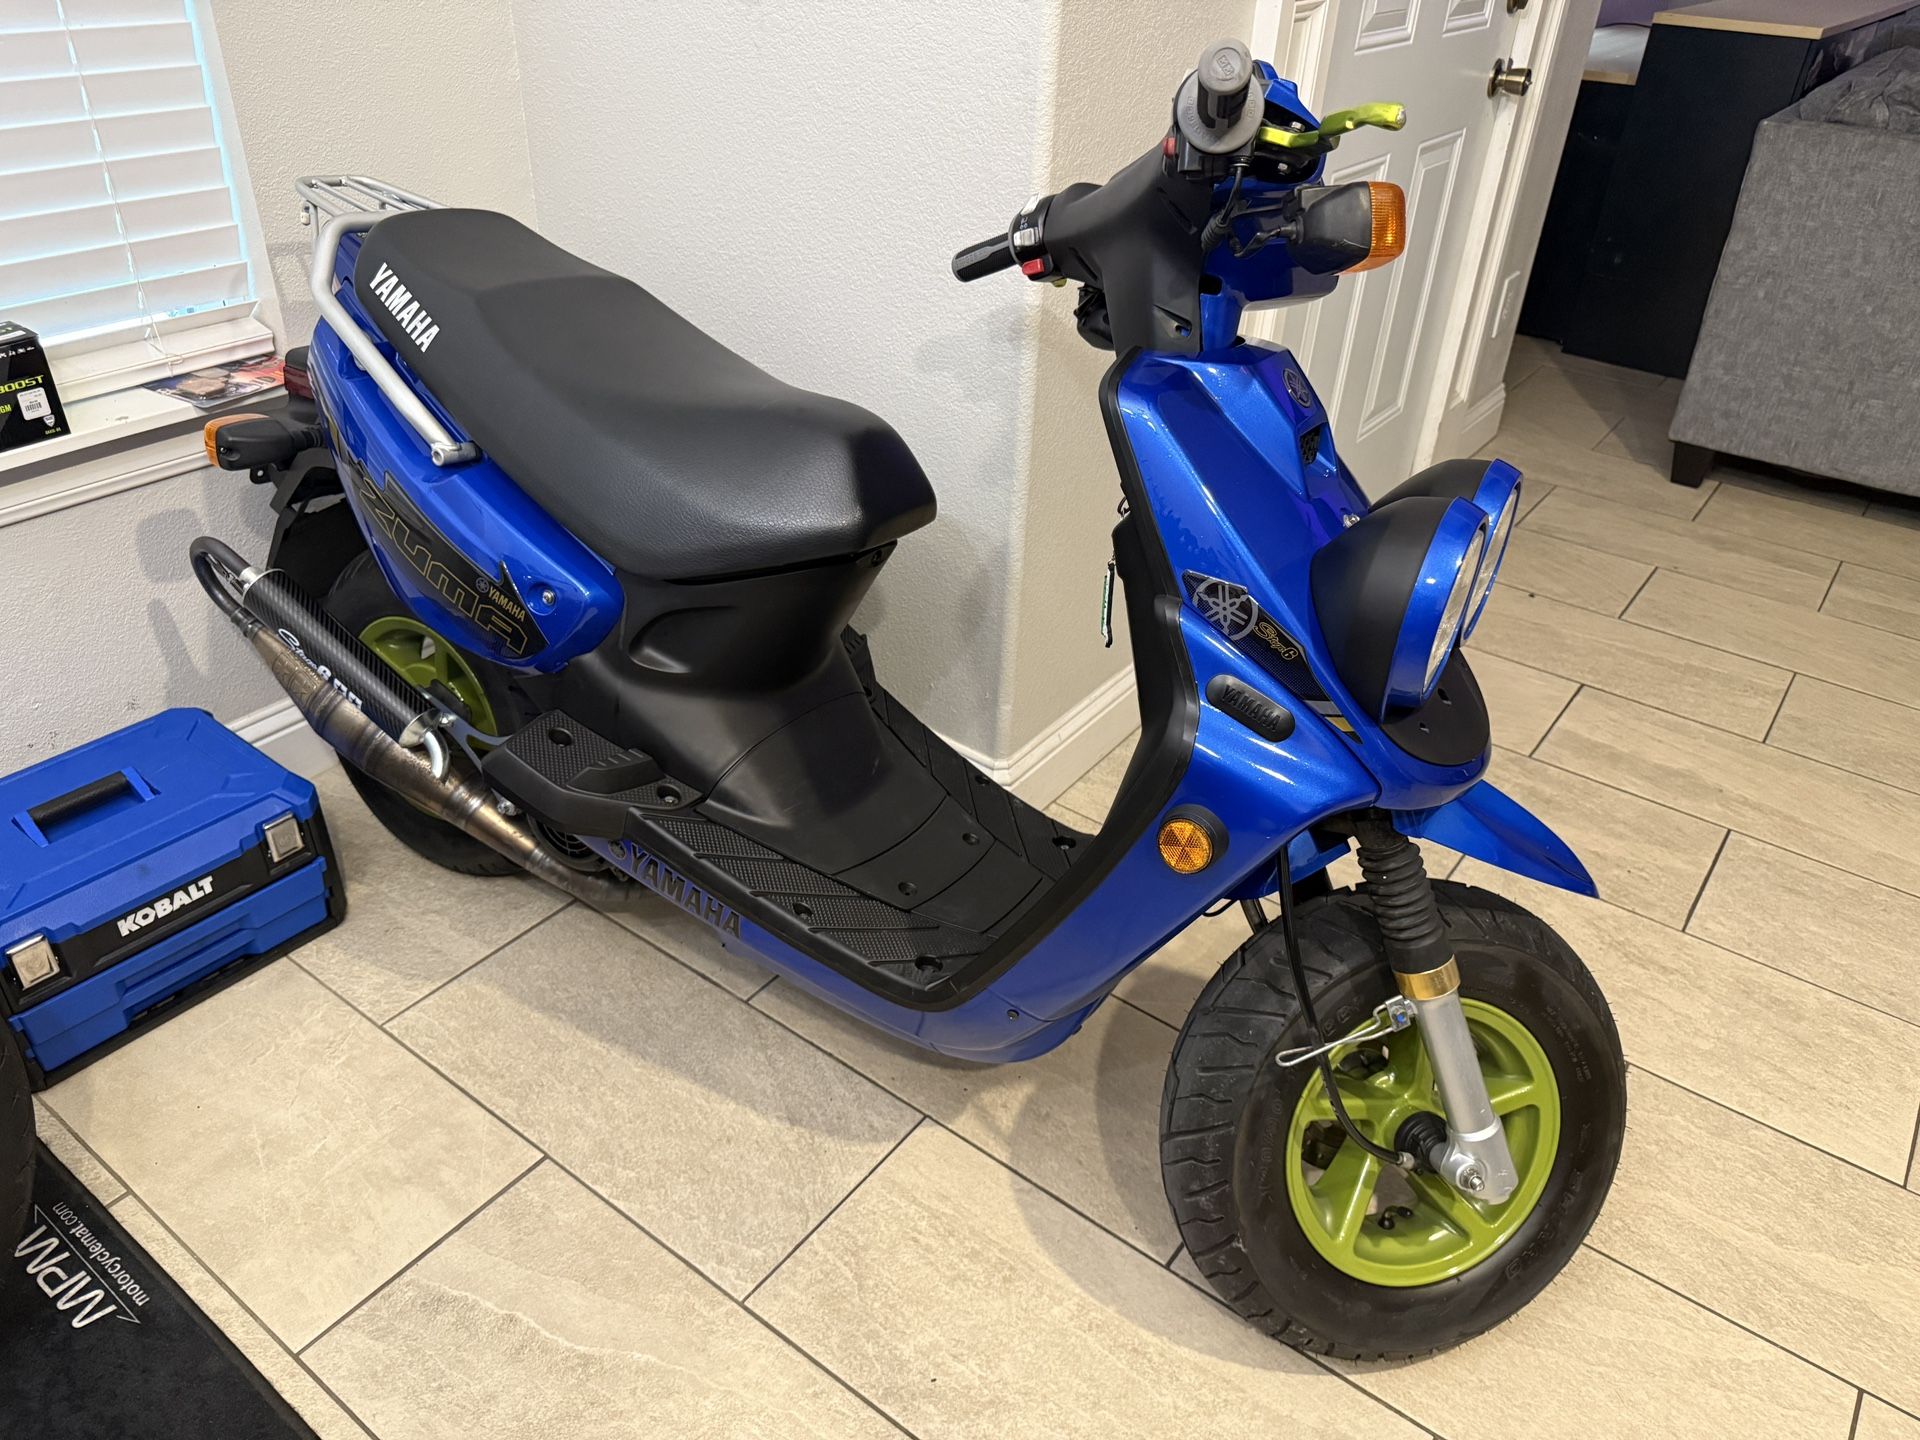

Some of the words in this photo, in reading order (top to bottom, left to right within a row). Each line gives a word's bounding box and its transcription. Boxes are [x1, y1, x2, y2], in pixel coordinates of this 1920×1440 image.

[369, 262, 440, 353] YAMAHA
[359, 476, 528, 656] ZUMA
[488, 586, 526, 622] YAMAHA
[1221, 684, 1282, 732] YAMAHA
[116, 876, 214, 937] KOBALT
[630, 842, 741, 939] YAMAHA
[14, 1224, 118, 1329] MPM
[52, 1201, 150, 1307] motorcyclemat.com
